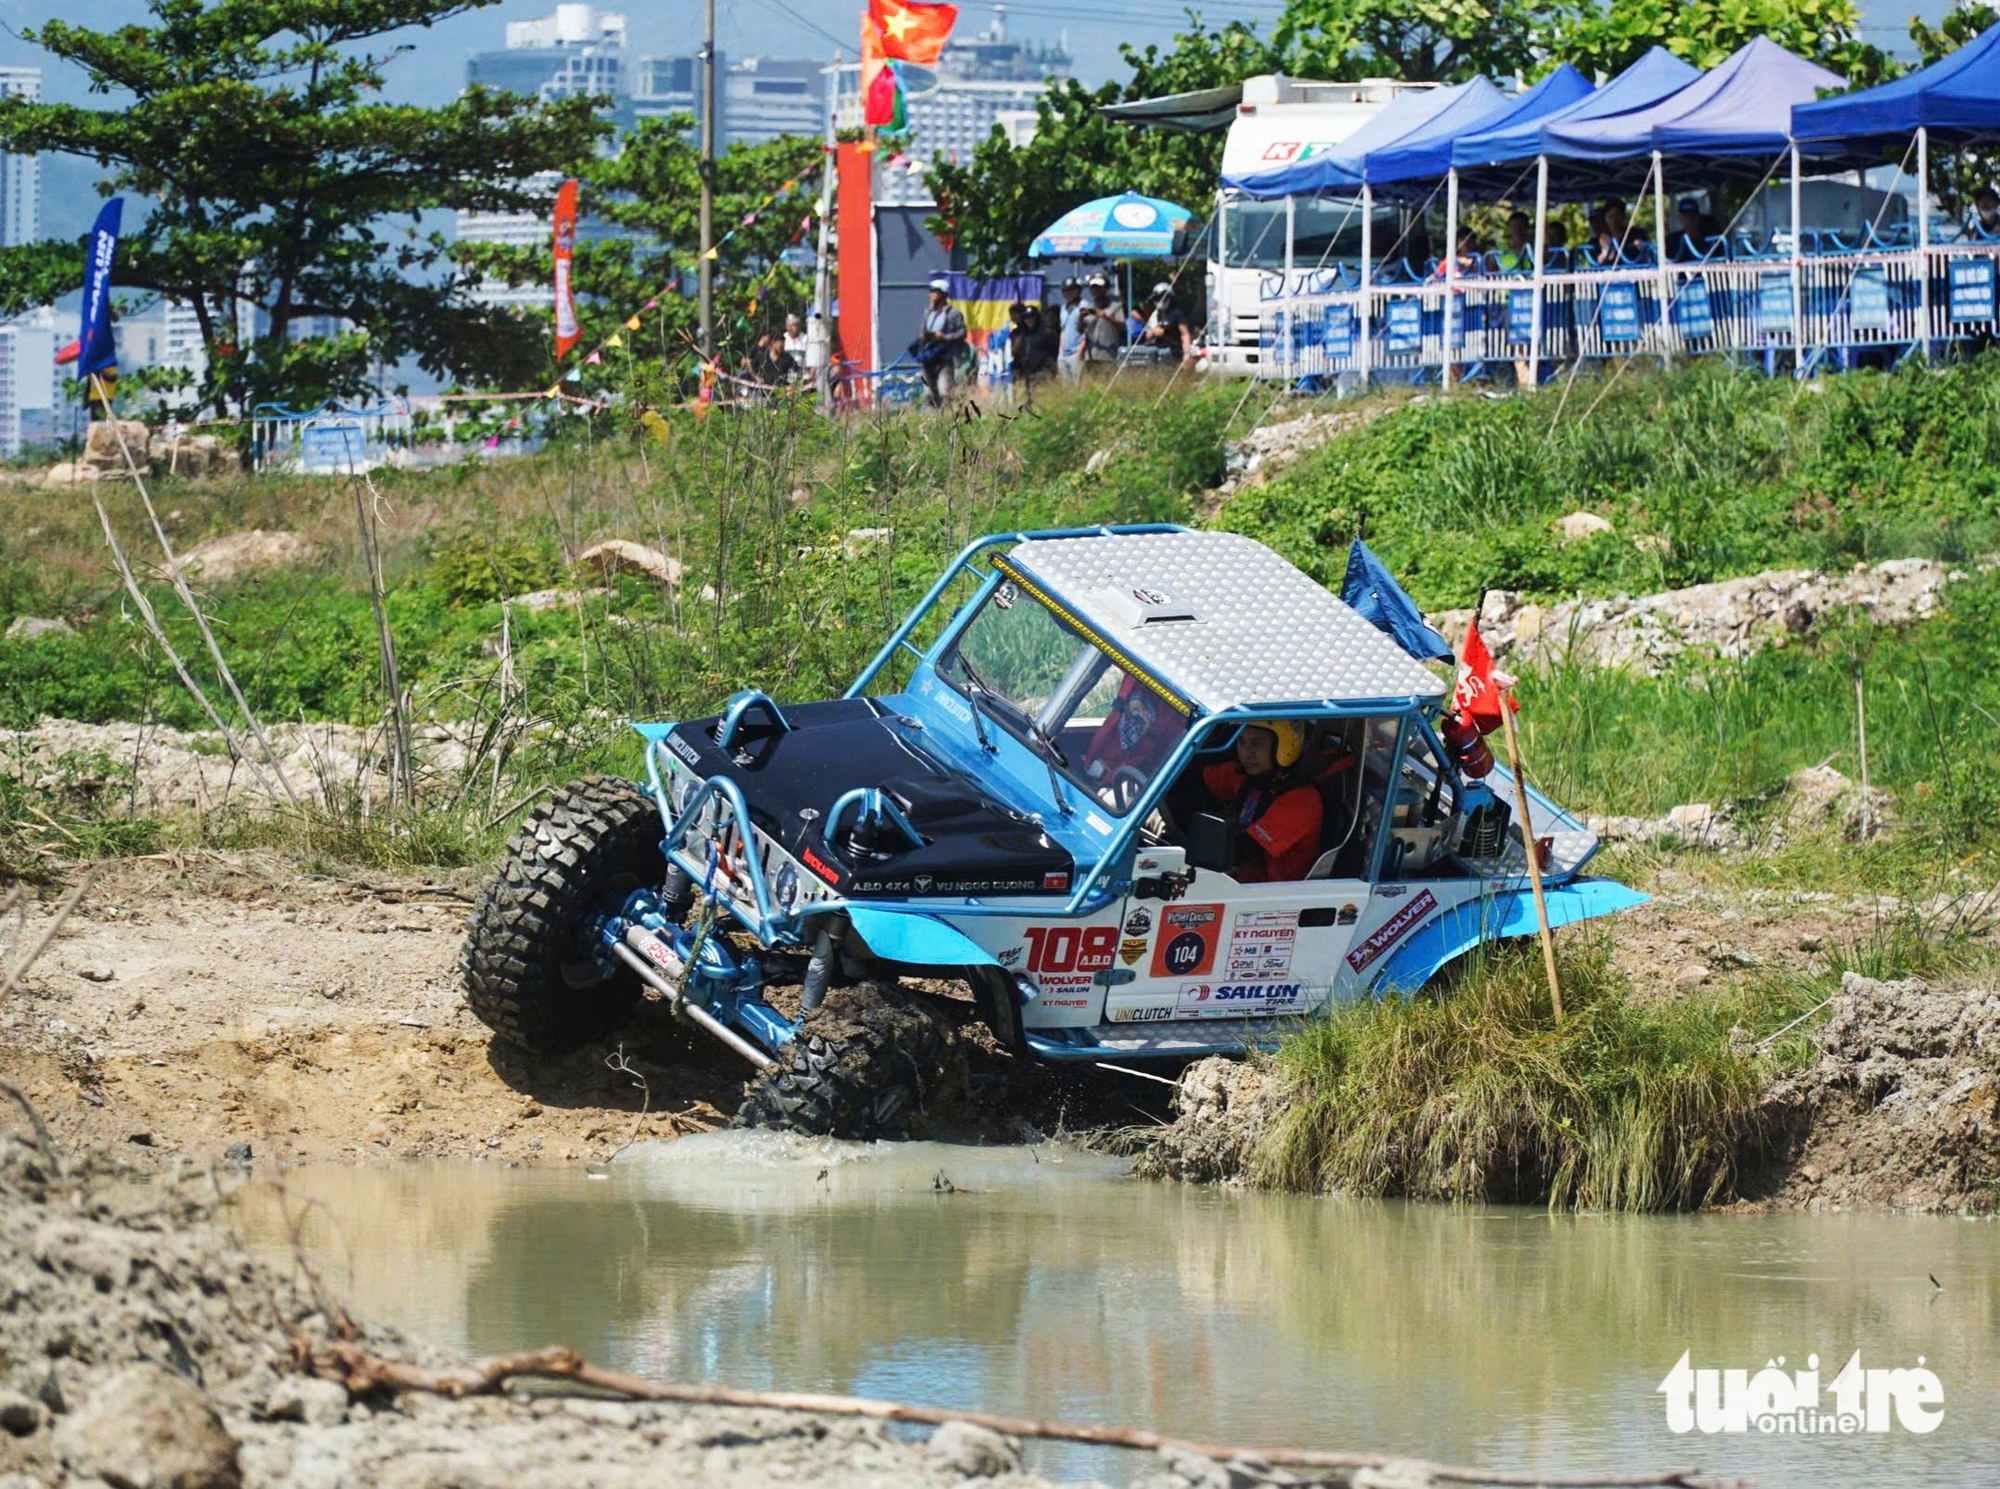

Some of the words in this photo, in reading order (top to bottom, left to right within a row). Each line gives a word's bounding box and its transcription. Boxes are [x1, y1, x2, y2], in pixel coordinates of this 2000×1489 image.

[666, 732, 702, 766] UNICLUTCH
[802, 846, 840, 885] WOLVER
[1369, 893, 1433, 948] WOLVER
[650, 942, 676, 964] PSC
[1023, 926, 1119, 973] 108
[1174, 945, 1198, 963] 104
[1262, 958, 1286, 968] Ford
[1037, 974, 1092, 985] WOLVER
[1055, 986, 1090, 994] SAILUN
[1215, 983, 1301, 1000] SAILUN
[1115, 1006, 1172, 1021] UNICLUTCH
